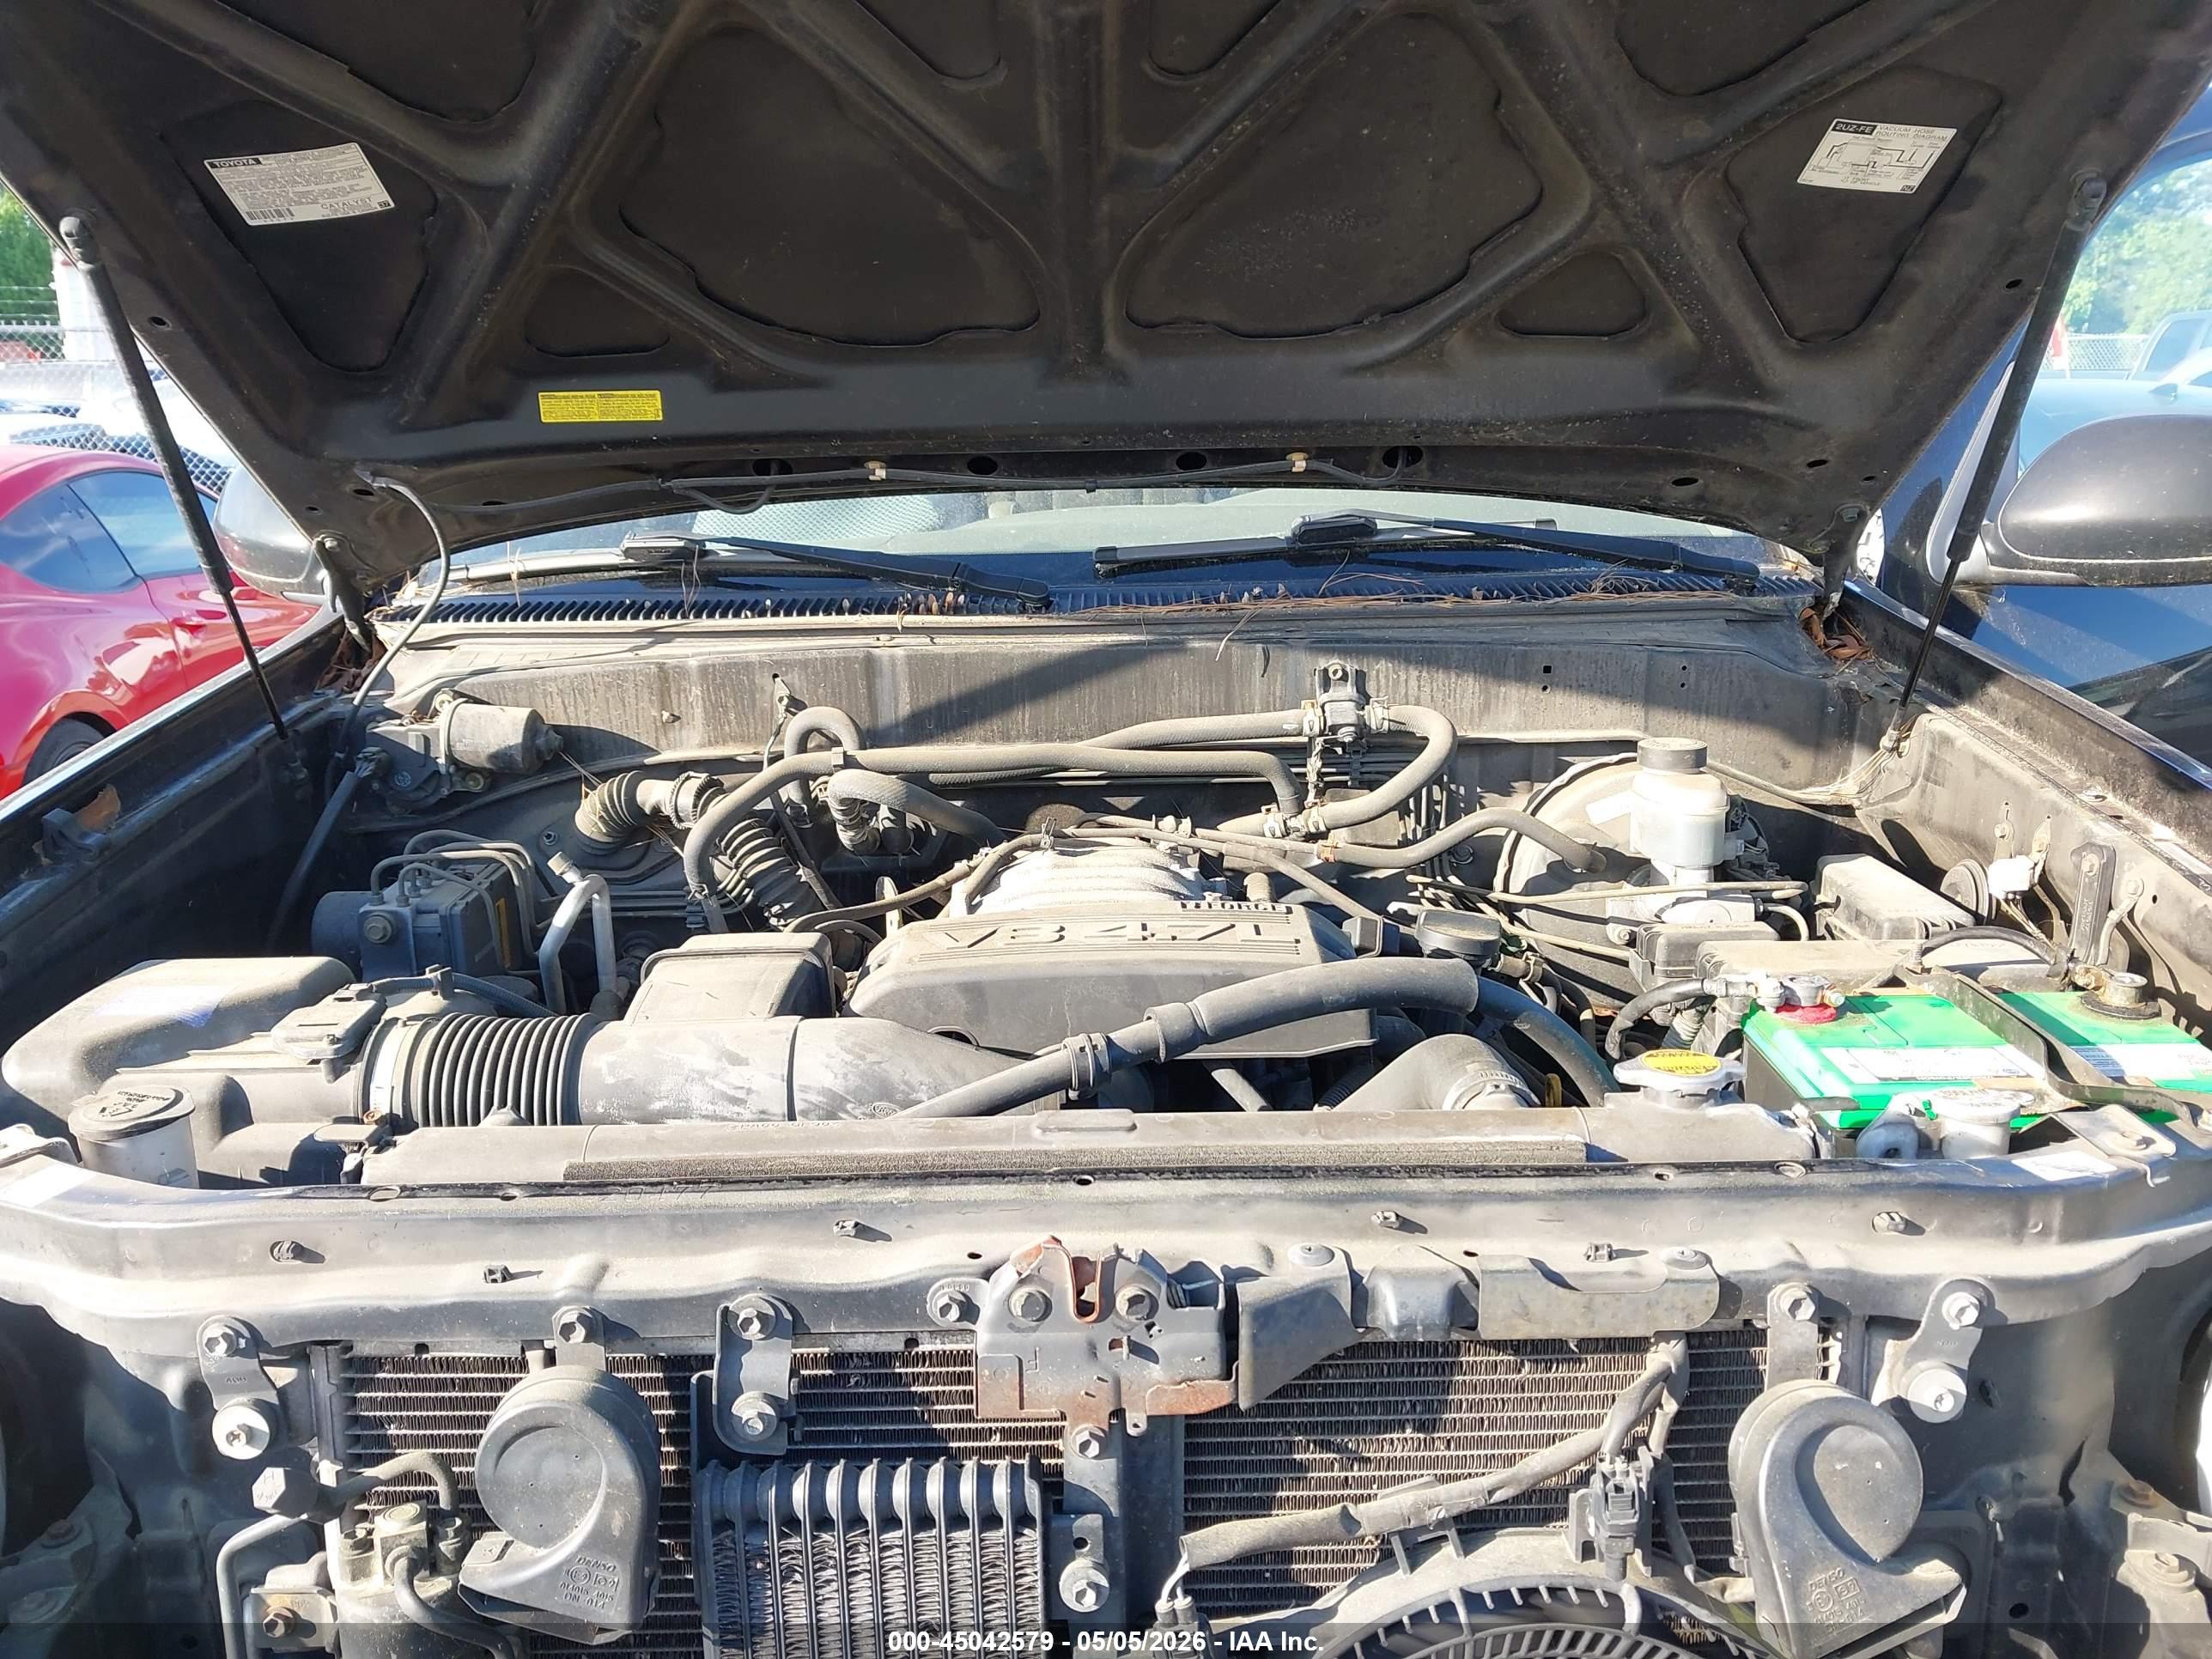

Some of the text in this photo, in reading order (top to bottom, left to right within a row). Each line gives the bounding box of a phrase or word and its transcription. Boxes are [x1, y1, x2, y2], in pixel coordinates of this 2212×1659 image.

[1835, 123, 1874, 133] 2UZ-FE
[214, 159, 257, 168] TOYOTA
[320, 197, 373, 210] CATALYST
[575, 1555, 617, 1573] DENSO
[1808, 1567, 1845, 1592] DENSO
